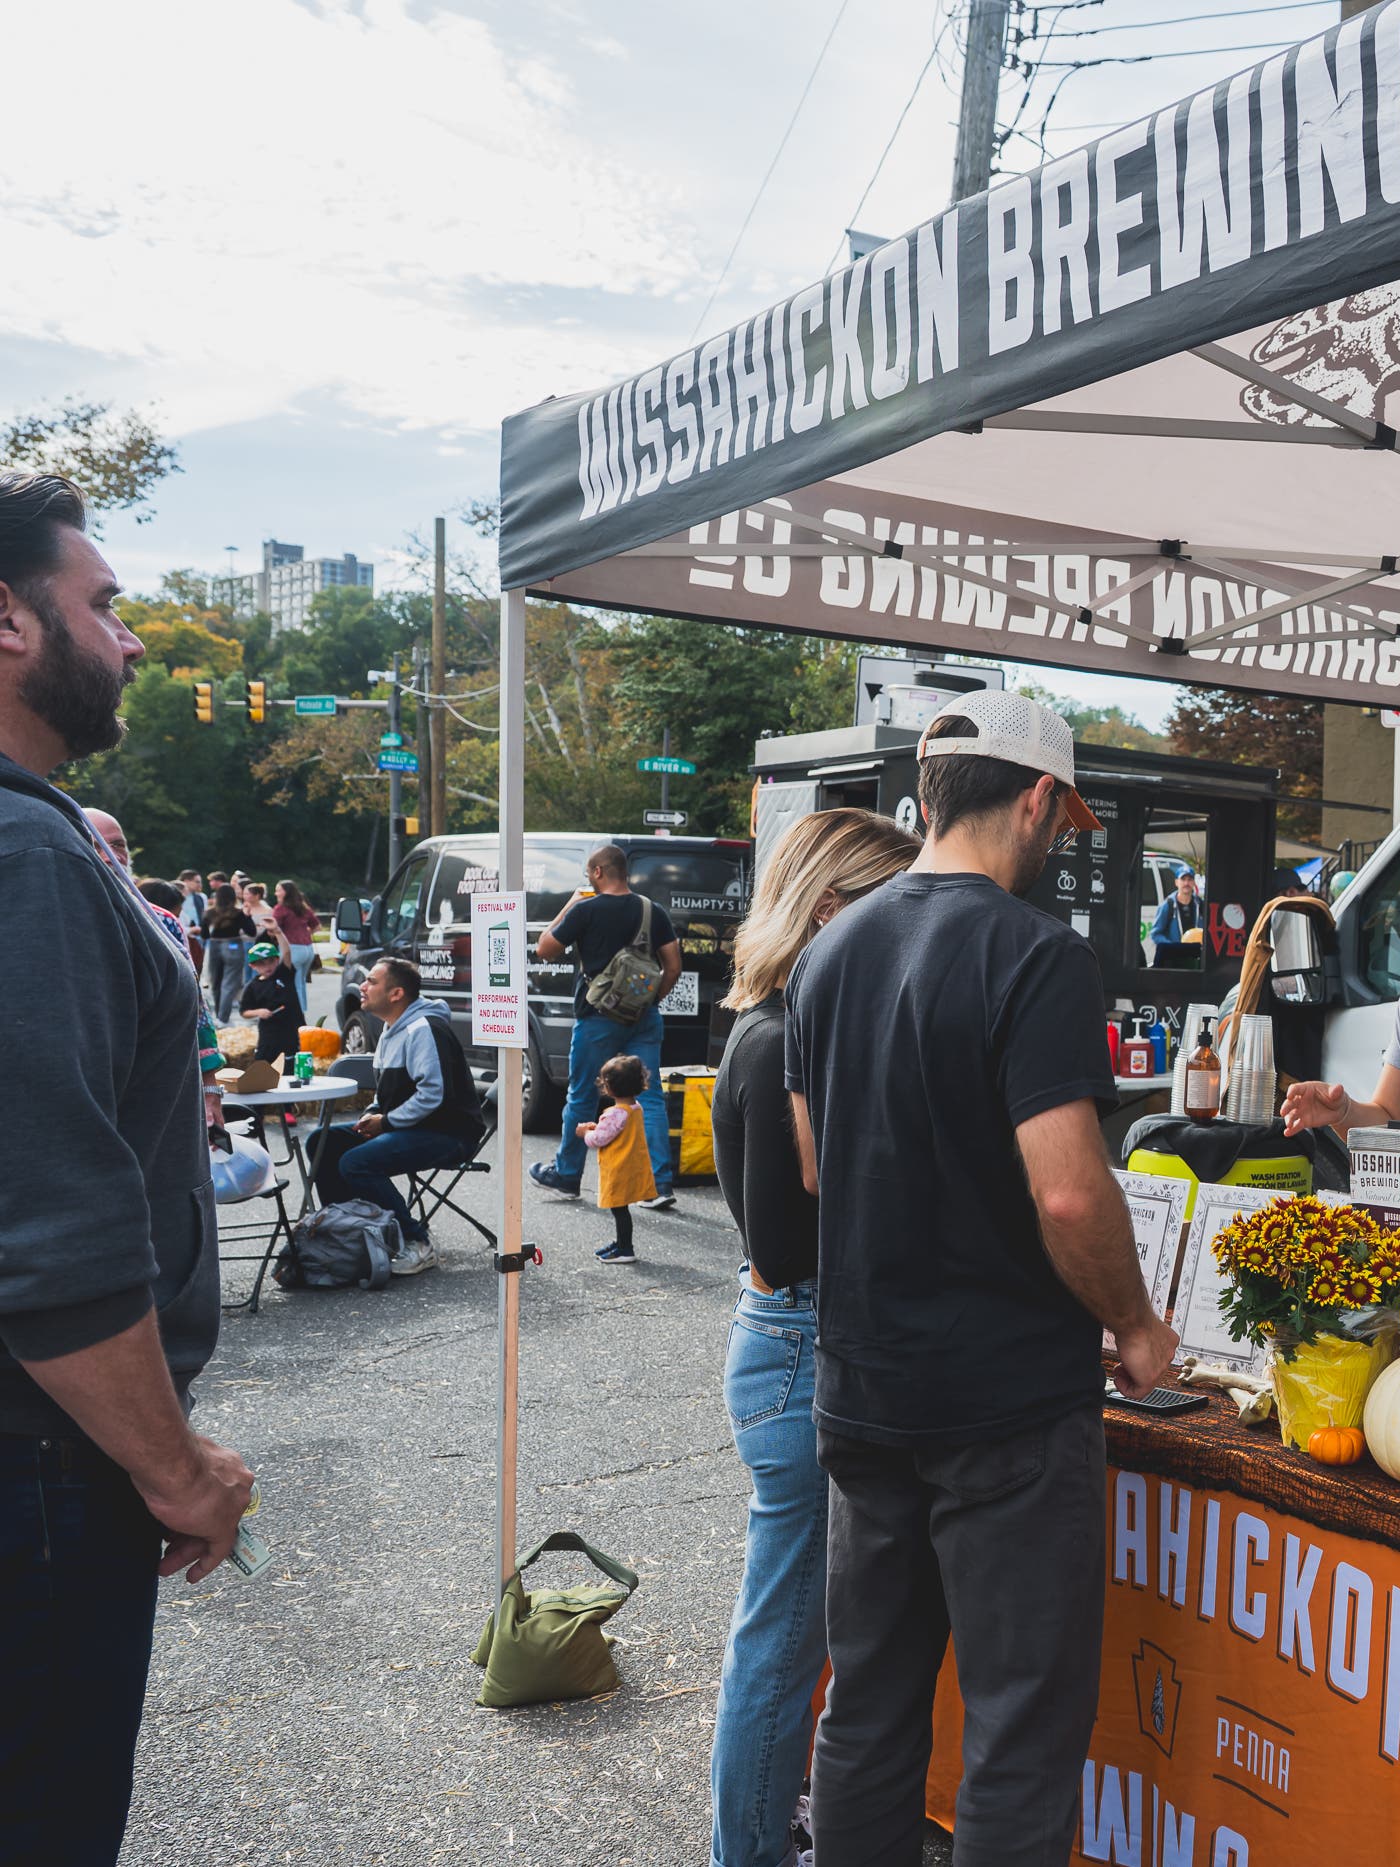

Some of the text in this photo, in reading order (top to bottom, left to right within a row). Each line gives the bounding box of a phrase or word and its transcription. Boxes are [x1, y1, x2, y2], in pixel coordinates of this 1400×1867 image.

[578, 208, 959, 521] WISSAHICKON
[477, 902, 517, 912] FESTIVAL MAP
[671, 896, 735, 911] HUMPTY'S
[477, 993, 519, 1004] PERFORMANCE
[482, 1023, 515, 1034] SCHEDULES
[1250, 1173, 1275, 1181] WASH
[1360, 1177, 1399, 1189] BREWING
[1215, 1715, 1291, 1795] PENNA
